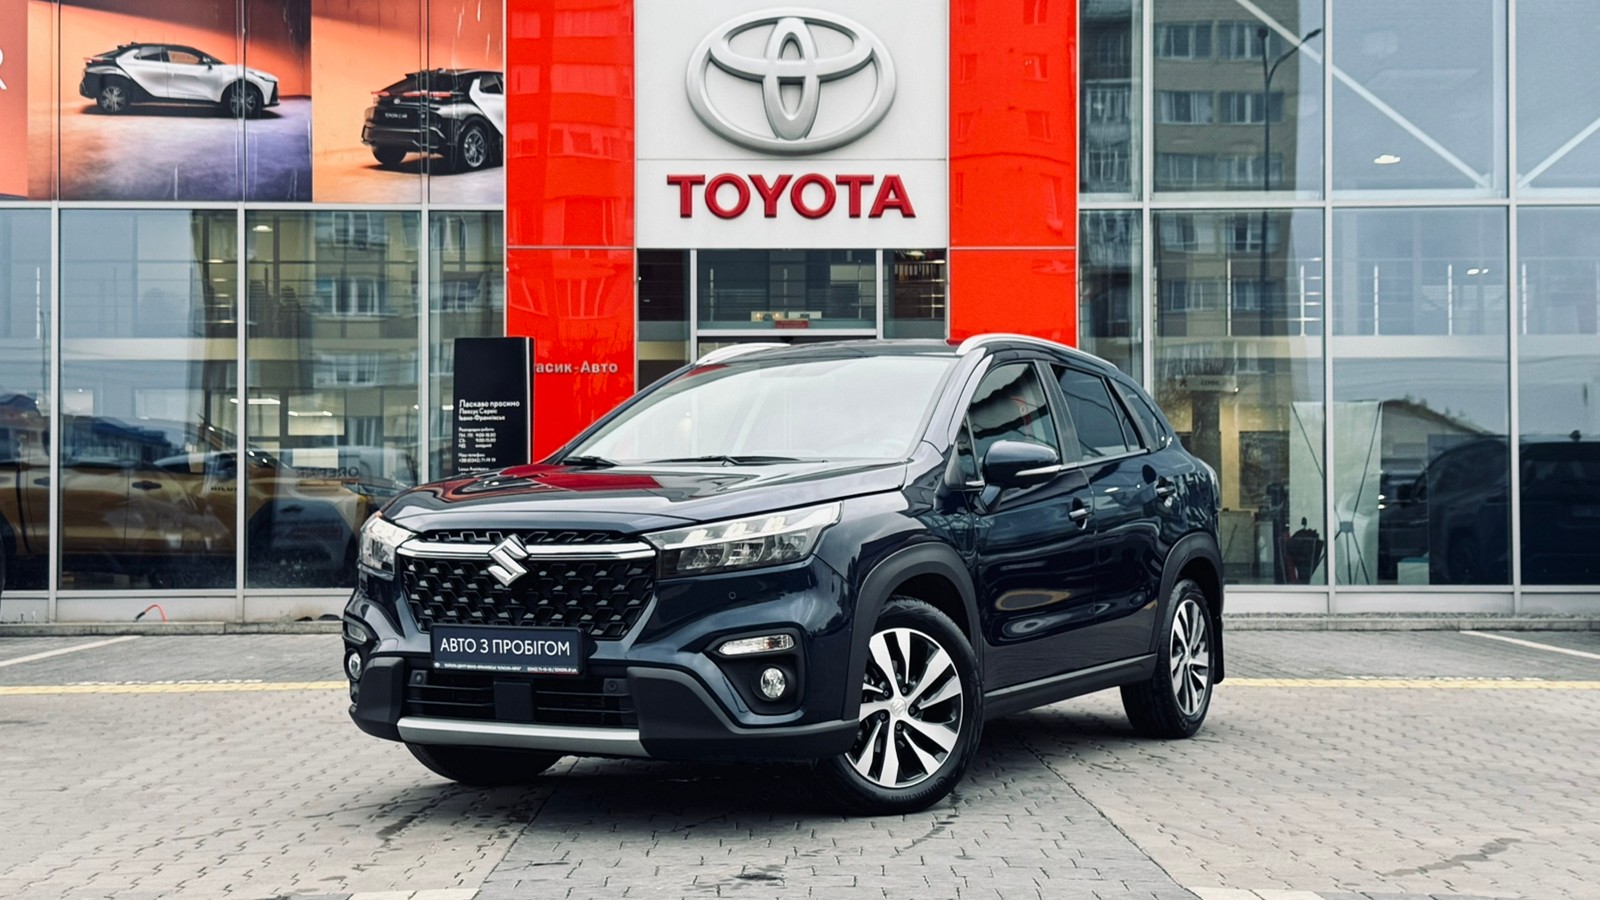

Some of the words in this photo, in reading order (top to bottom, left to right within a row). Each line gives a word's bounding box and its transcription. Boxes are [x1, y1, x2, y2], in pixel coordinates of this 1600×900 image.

[667, 173, 916, 219] TOYOTA
[536, 360, 618, 374] асик-Авто
[490, 401, 520, 409] просимо
[440, 638, 477, 653] АВТО
[480, 639, 489, 653] З
[492, 639, 570, 656] ПРОБІГОМ
